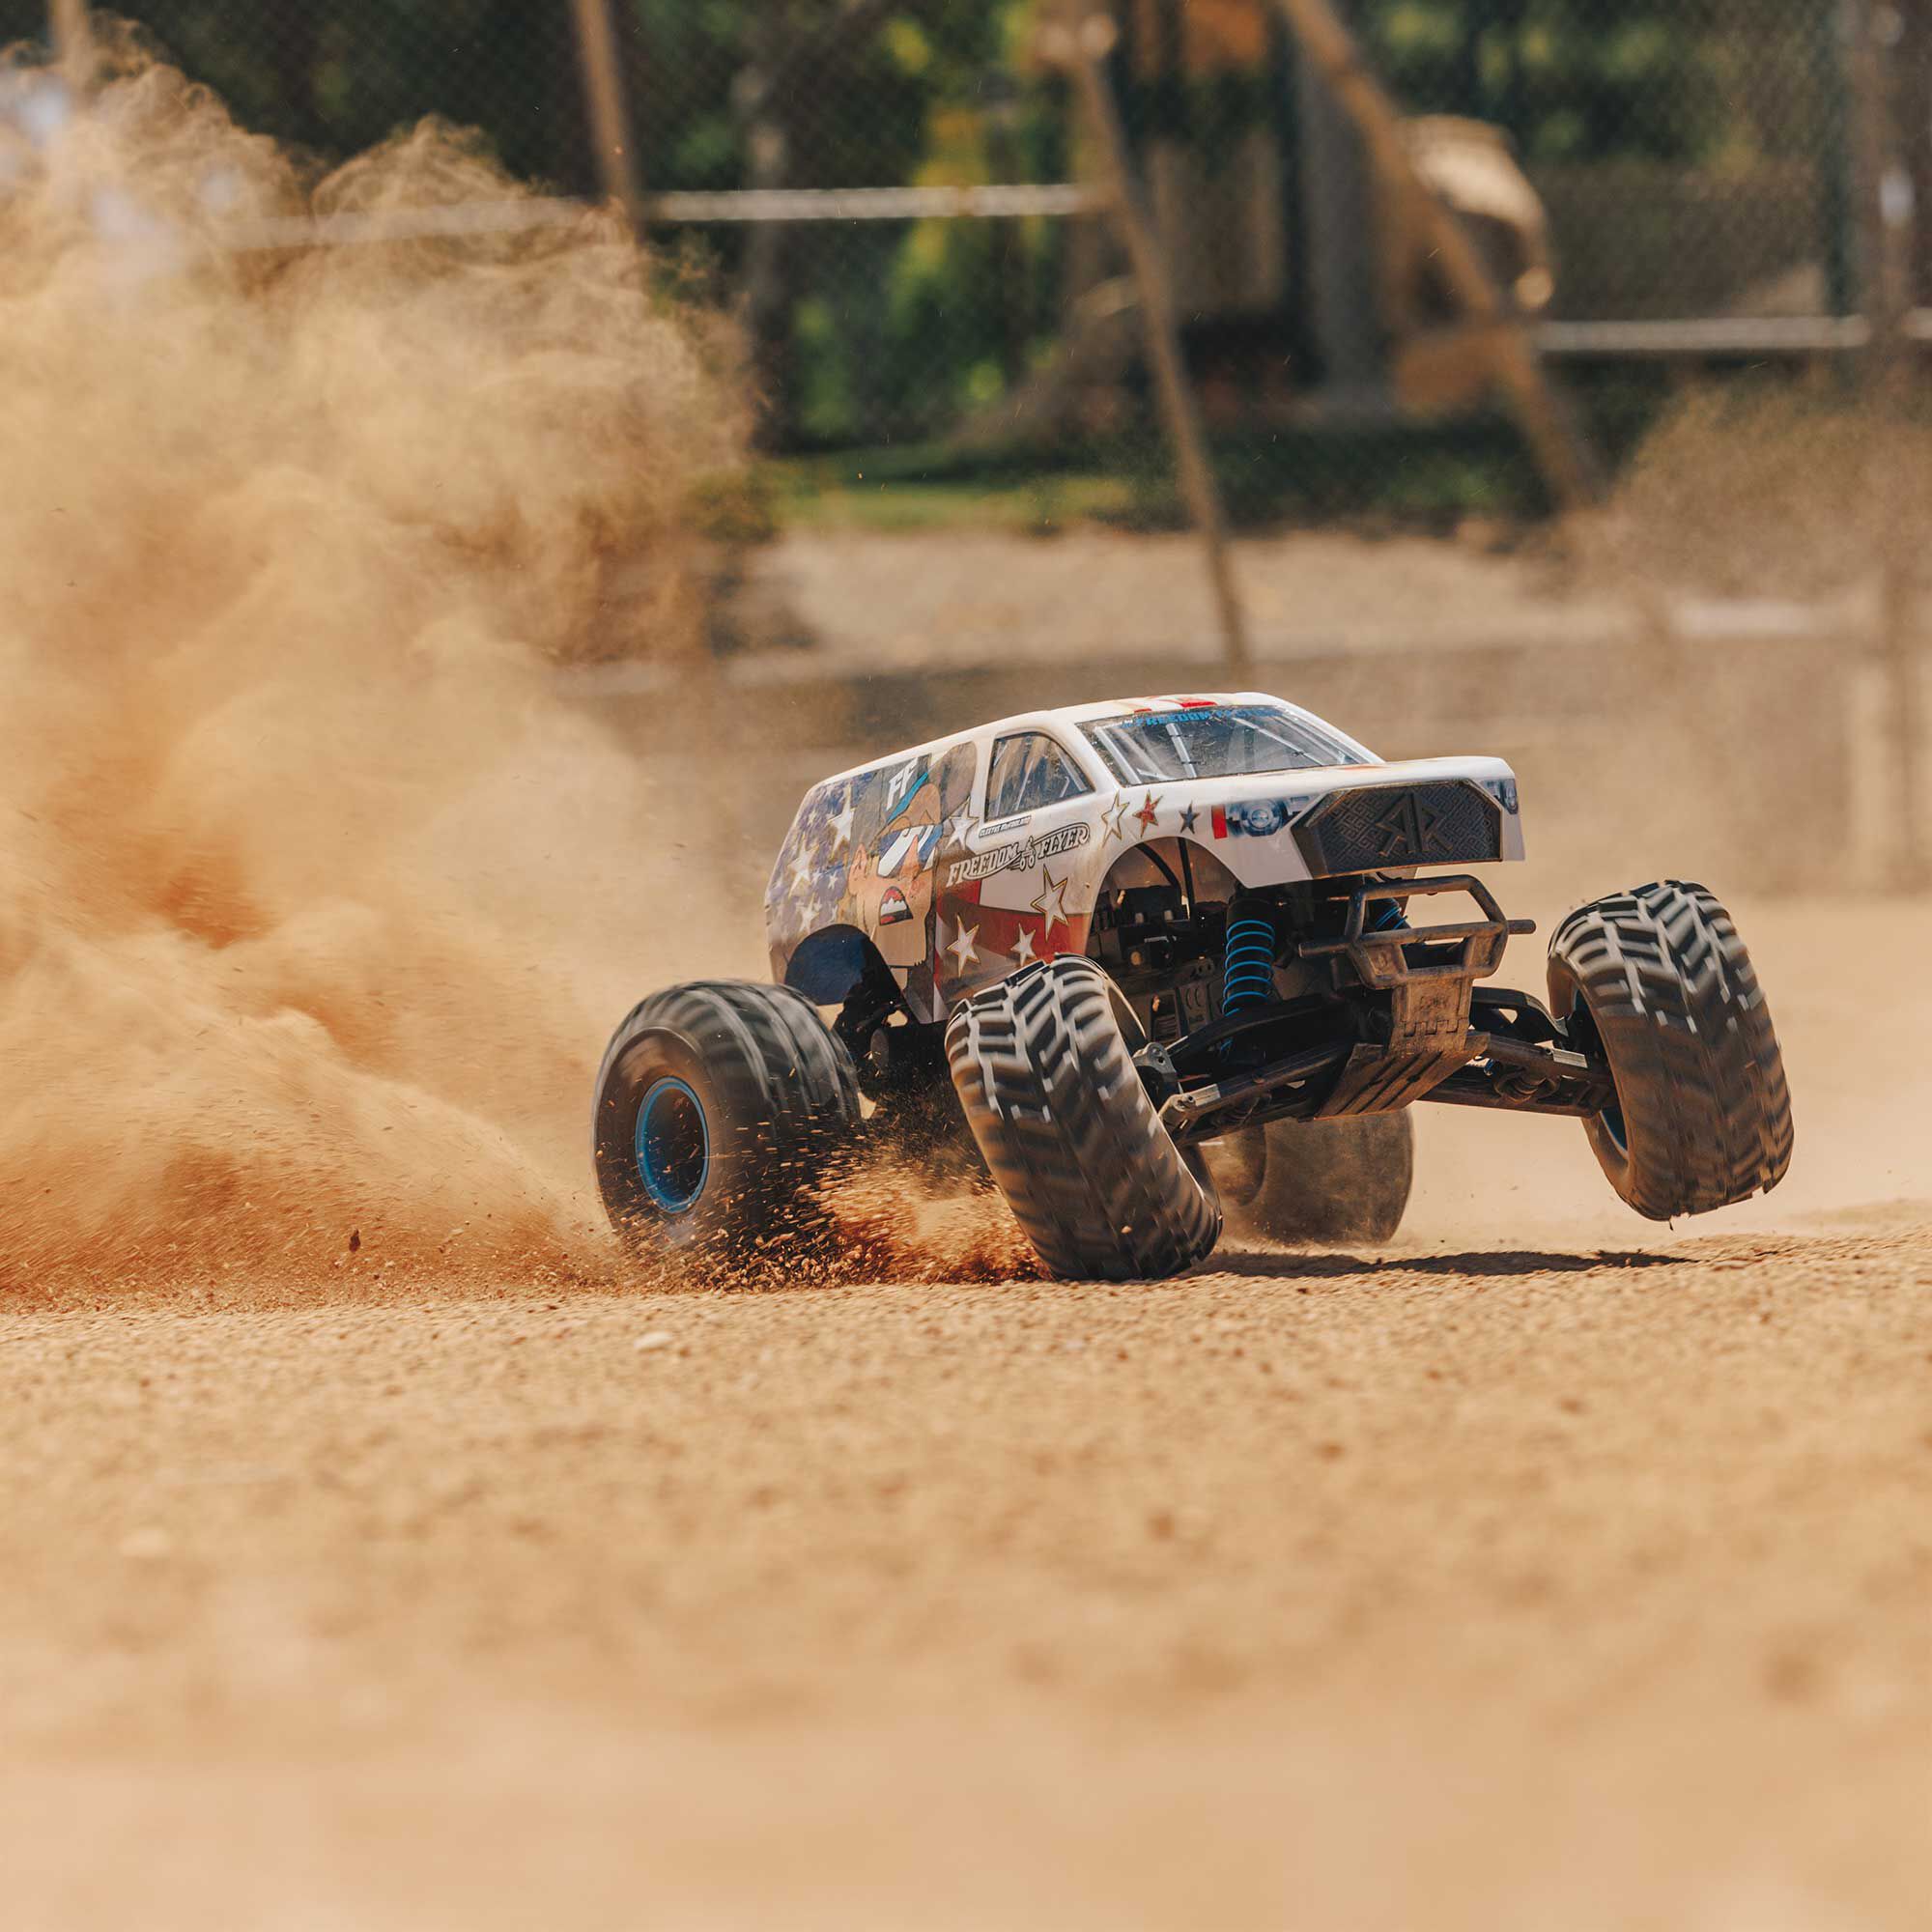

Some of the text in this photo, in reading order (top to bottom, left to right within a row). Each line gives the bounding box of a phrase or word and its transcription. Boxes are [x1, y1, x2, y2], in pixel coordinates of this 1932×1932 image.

[886, 757, 919, 811] FF
[945, 841, 1022, 888] FREEDOM
[1037, 822, 1091, 860] FLYER
